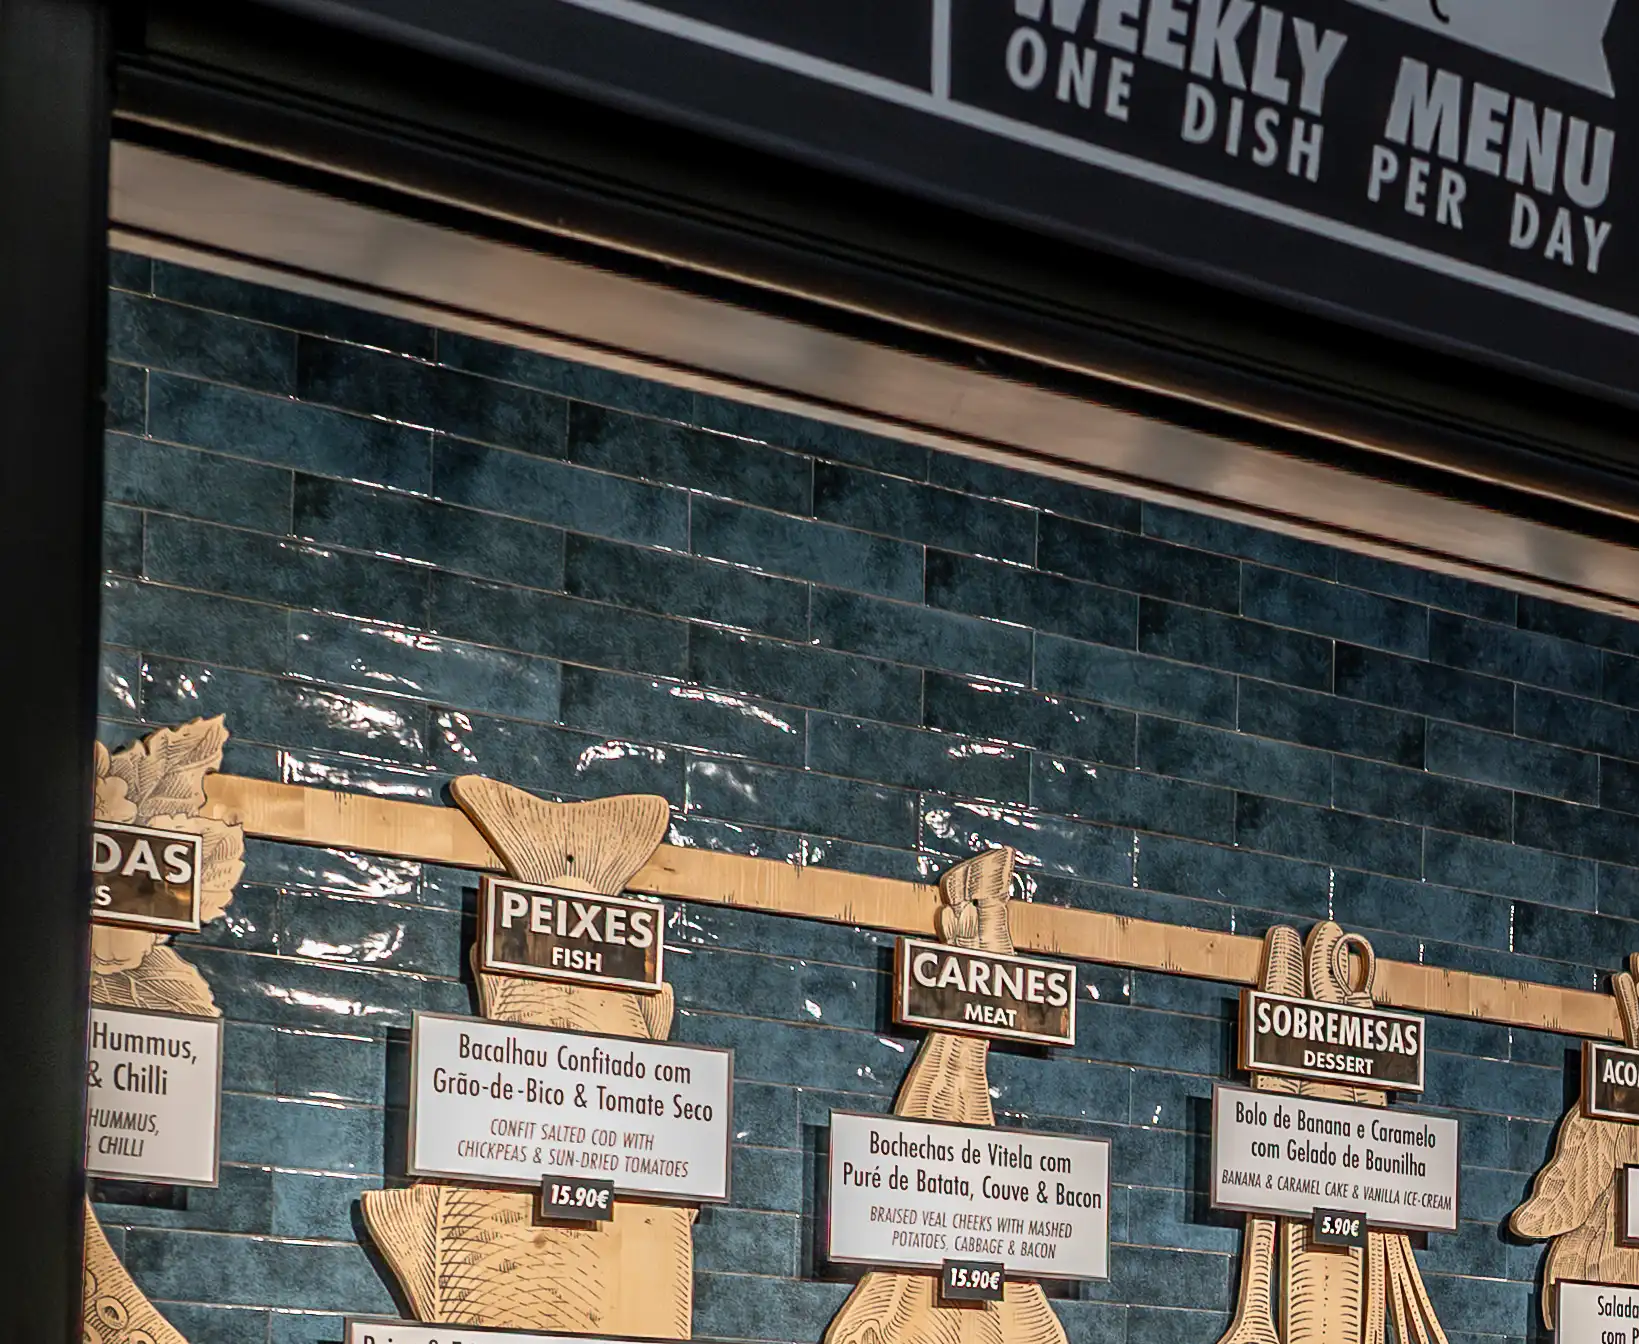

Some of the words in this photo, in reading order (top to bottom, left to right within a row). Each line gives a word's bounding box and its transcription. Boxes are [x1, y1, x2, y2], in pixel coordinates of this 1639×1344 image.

[1006, 28, 1135, 122] ONE
[1181, 81, 1324, 183] DISH
[1367, 144, 1467, 228] PER
[1508, 192, 1612, 274] DAY
[1385, 56, 1615, 209] MENU
[501, 891, 653, 949] PEIXES
[552, 946, 602, 973] FISH
[913, 952, 1068, 1007] CARNES
[964, 1003, 1017, 1027] MEAT
[1257, 1002, 1418, 1056] SOBREMESAS
[92, 1019, 199, 1066] Hummus,
[459, 1033, 547, 1069] Bacalhau
[558, 1045, 646, 1080] Confitado
[654, 1063, 691, 1085] com
[114, 1060, 168, 1097] Chilli
[1303, 1050, 1374, 1075] DESSERT
[574, 1085, 587, 1108] &
[597, 1085, 664, 1117] Tomate
[673, 1095, 713, 1123] Seco
[550, 1183, 610, 1210] 15.90€
[1322, 1217, 1360, 1237] 5.90€
[950, 1267, 1000, 1290] 15.90€
